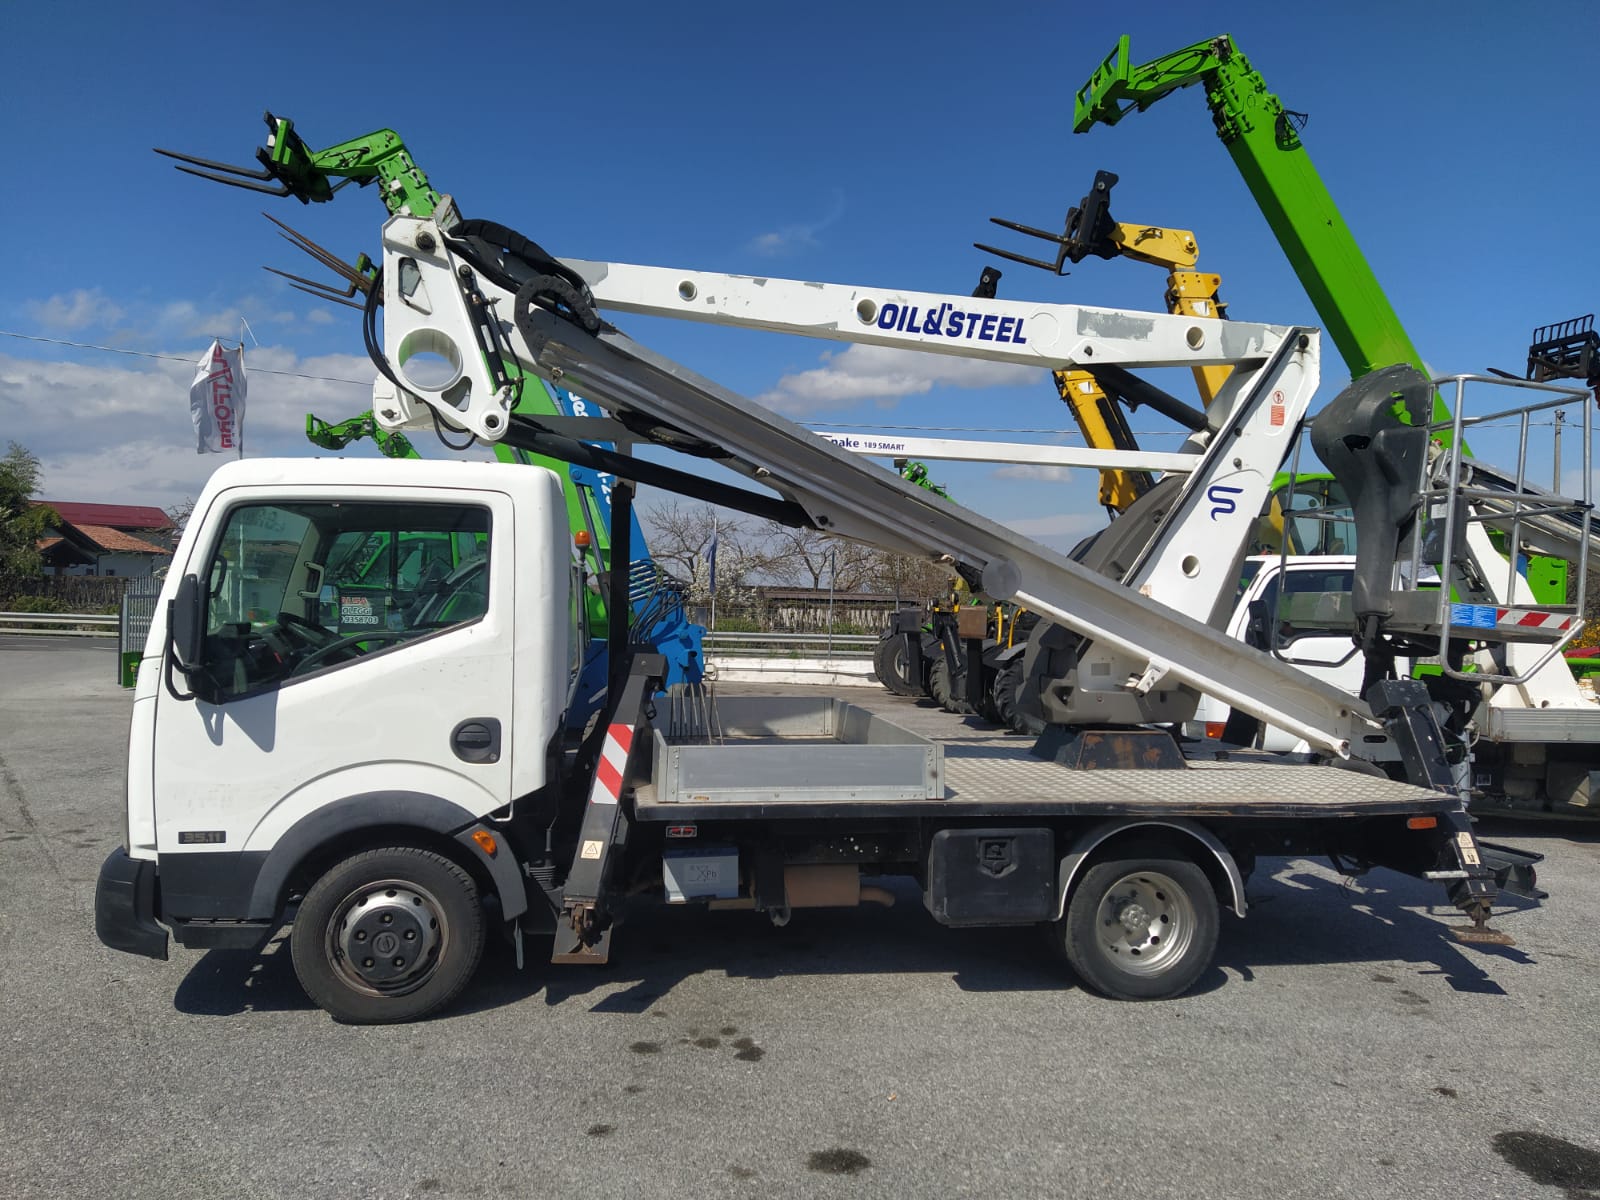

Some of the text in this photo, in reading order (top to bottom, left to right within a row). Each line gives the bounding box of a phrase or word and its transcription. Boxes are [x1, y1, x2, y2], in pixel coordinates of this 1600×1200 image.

[820, 435, 905, 451] nake 189 SMART
